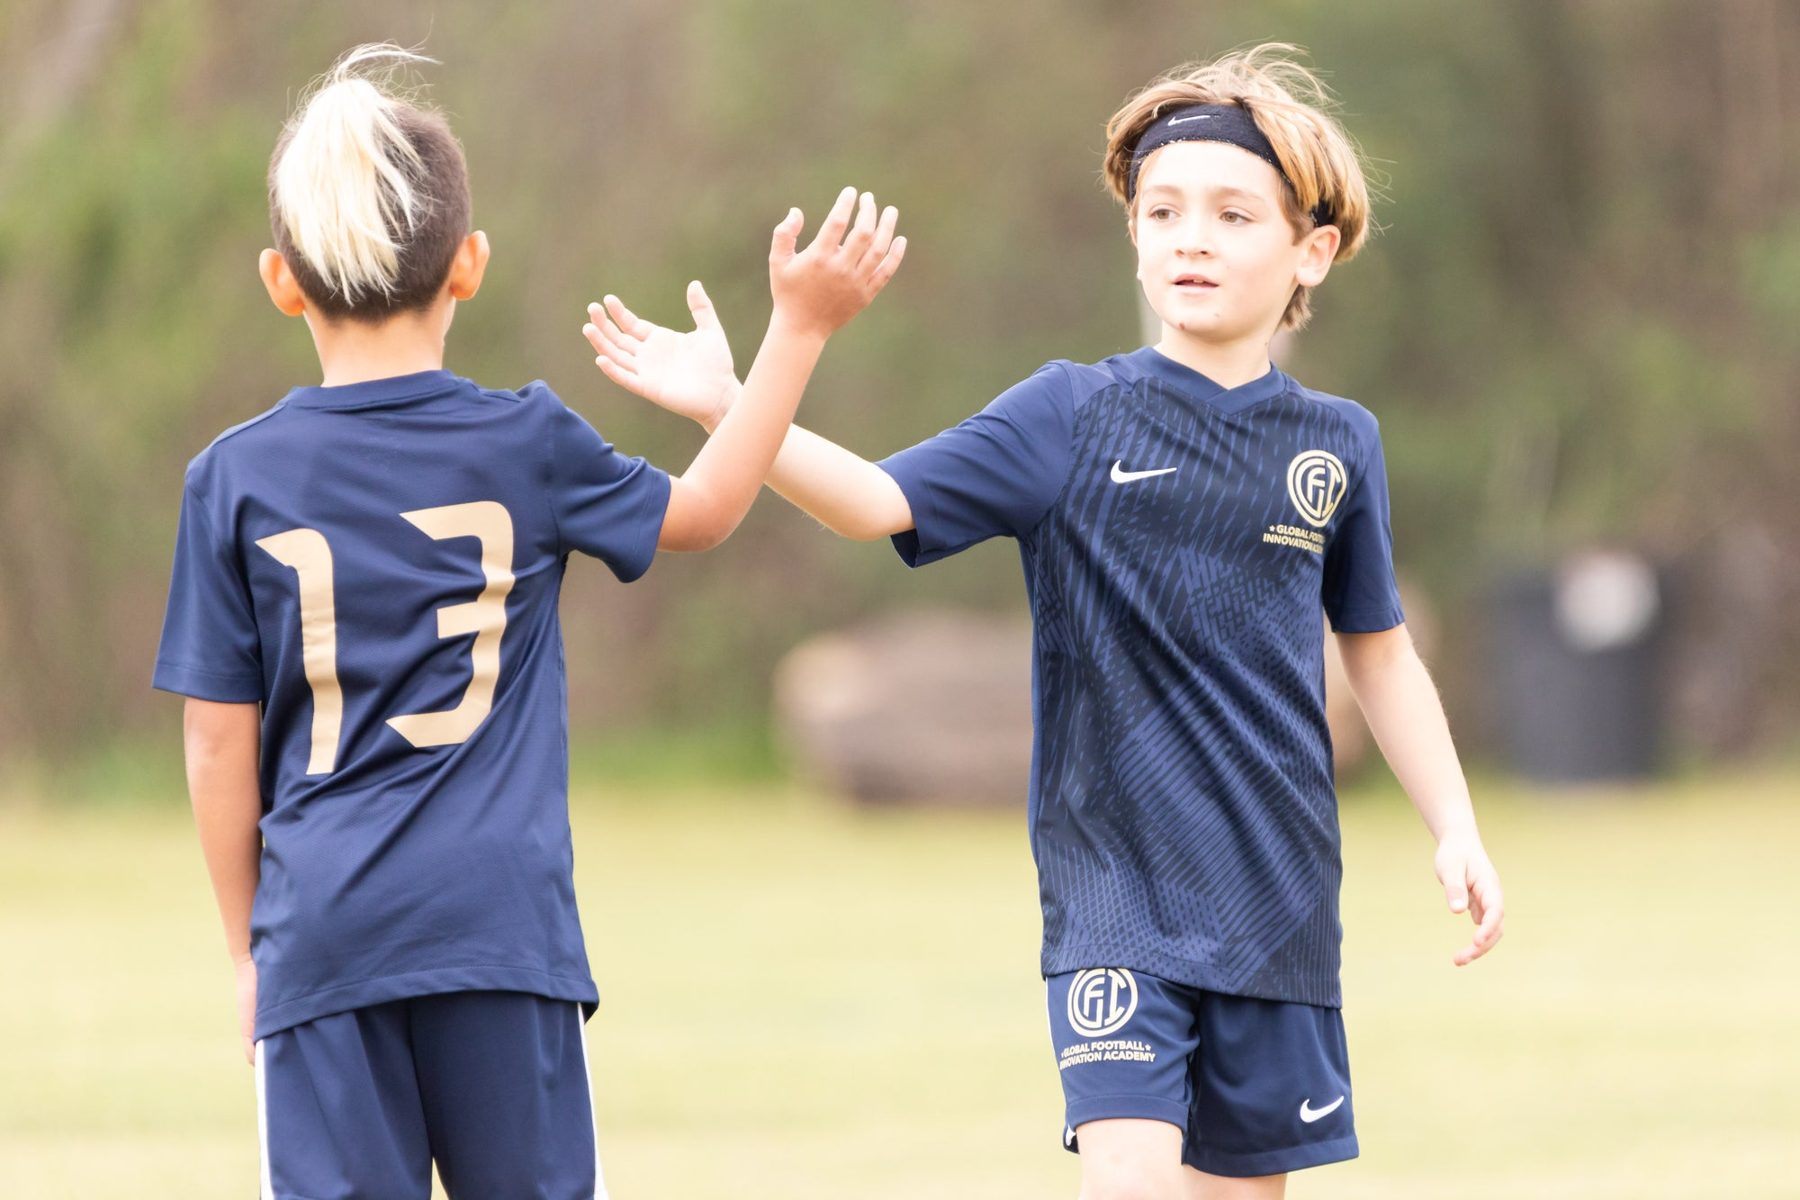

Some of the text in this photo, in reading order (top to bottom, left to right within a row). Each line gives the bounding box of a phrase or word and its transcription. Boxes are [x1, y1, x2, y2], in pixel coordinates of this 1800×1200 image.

[1276, 524, 1309, 539] GLOBAL
[254, 500, 515, 775] 13
[1091, 1040, 1144, 1051] FOOTBALL
[1103, 1050, 1156, 1063] ACADEMY
